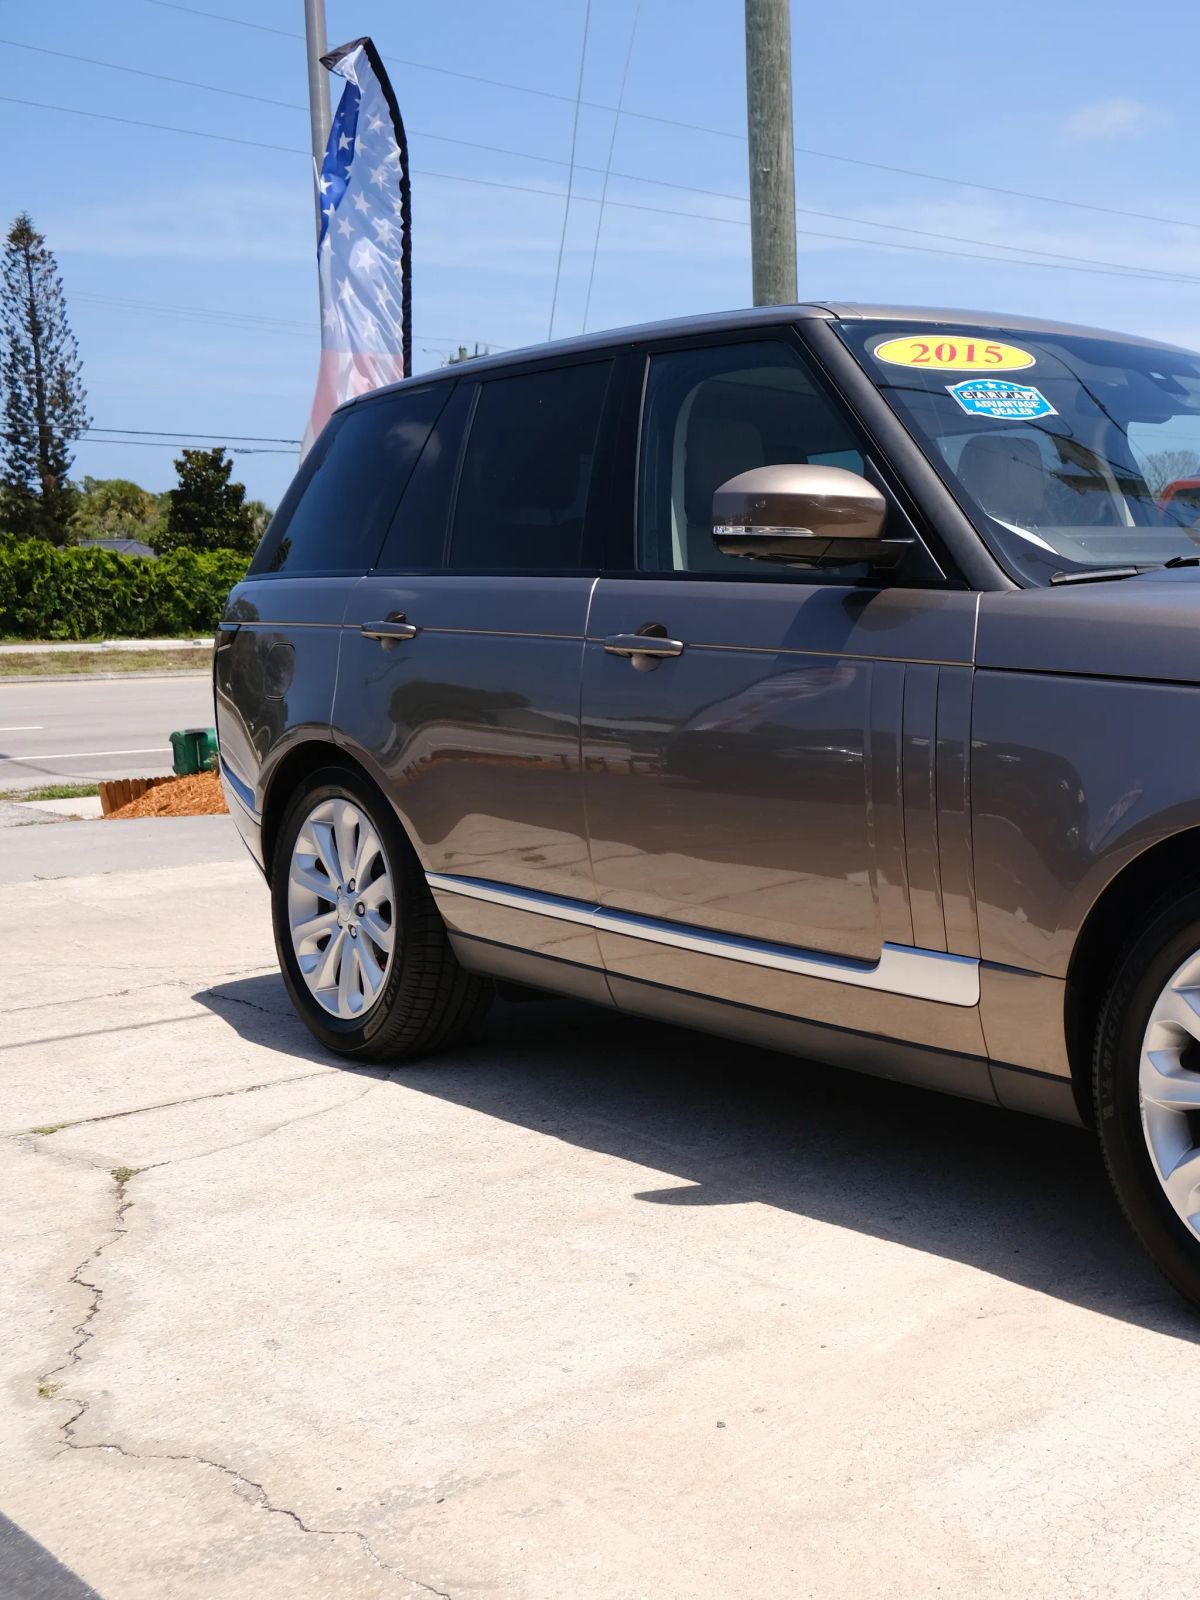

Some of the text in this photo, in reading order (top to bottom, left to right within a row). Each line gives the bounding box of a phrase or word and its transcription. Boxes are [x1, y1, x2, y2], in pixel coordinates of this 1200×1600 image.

[910, 343, 1003, 363] 2015
[975, 400, 1040, 409] ADVANTAGE
[991, 407, 1036, 416] DEALER
